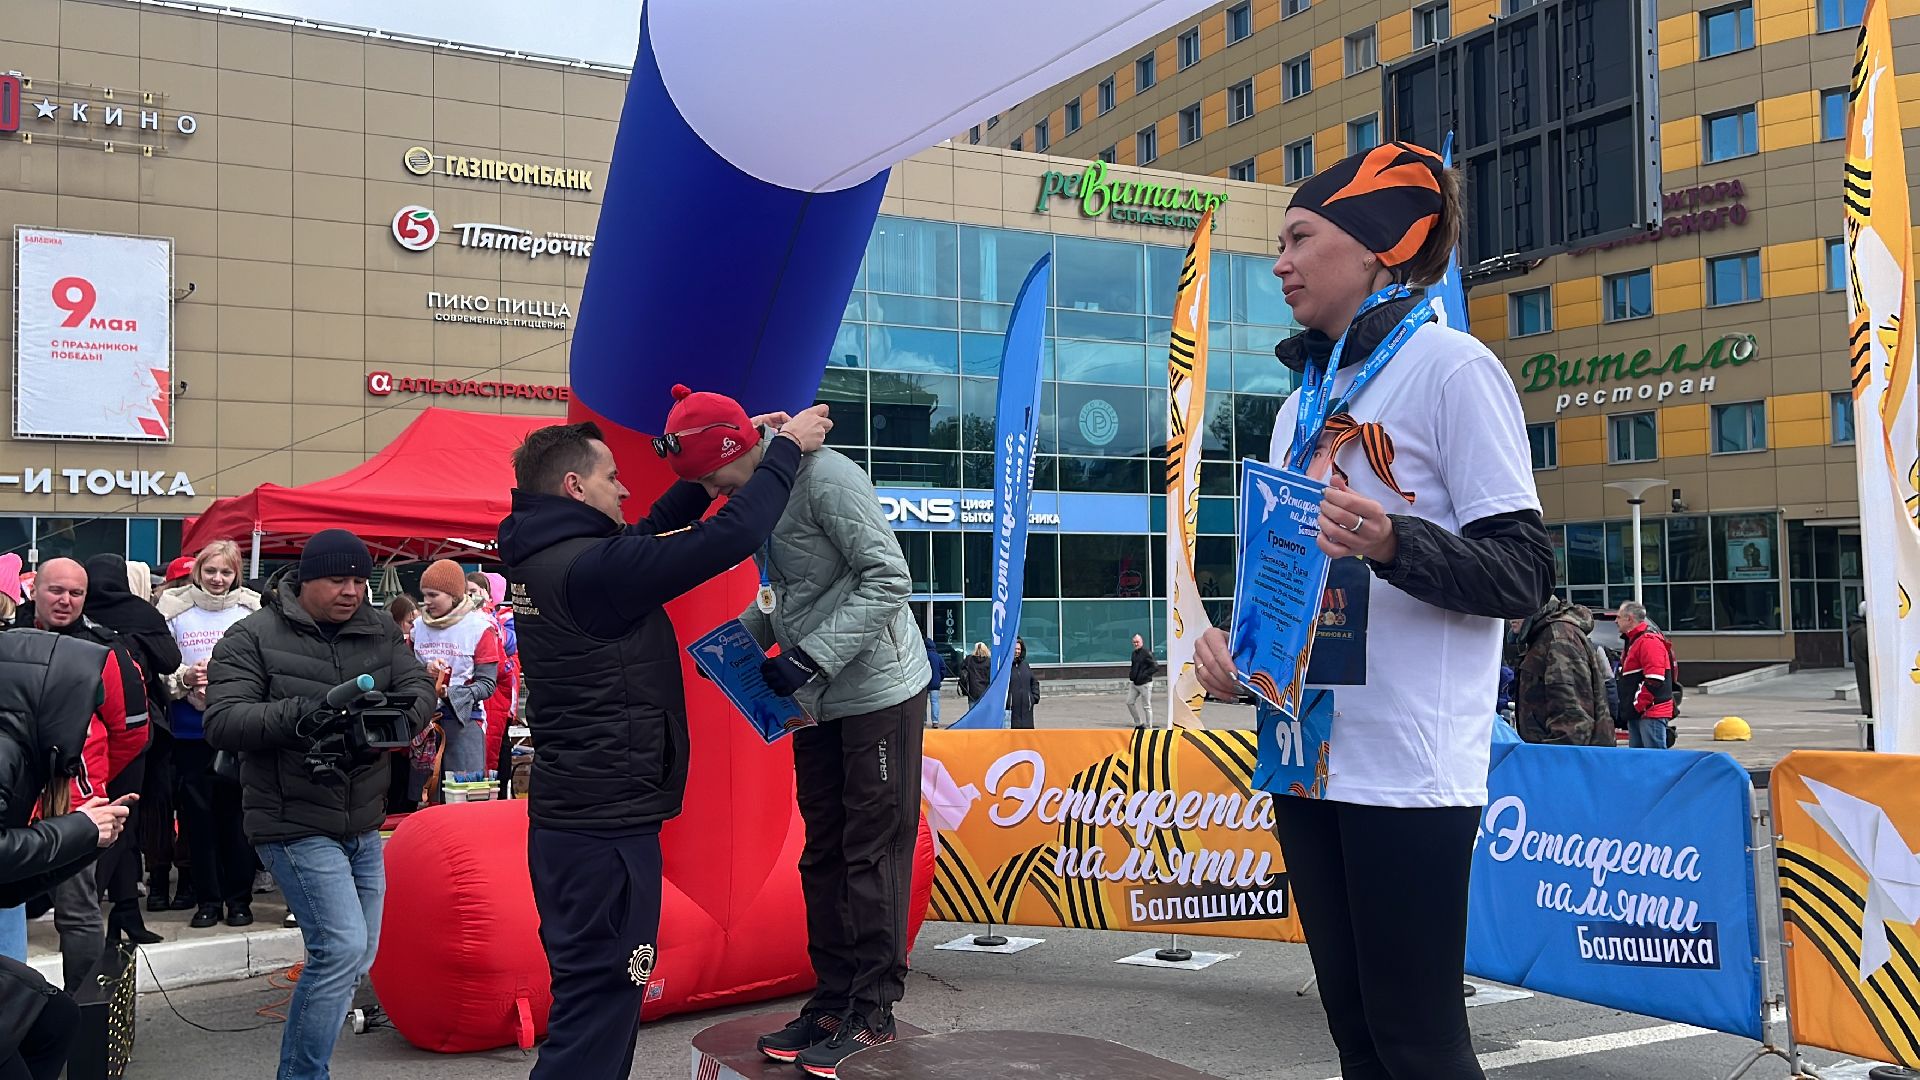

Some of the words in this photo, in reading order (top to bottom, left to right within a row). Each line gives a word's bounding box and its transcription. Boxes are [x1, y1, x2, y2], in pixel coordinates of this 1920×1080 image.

[72, 102, 197, 135] КИНО
[445, 155, 593, 191] ГАЗПРОМБАНК
[25, 235, 63, 246] БАЛАШИХА
[452, 223, 595, 258] Пятёрочк
[51, 276, 97, 328] 9
[89, 318, 137, 332] мая
[428, 292, 489, 311] ПИКО
[497, 298, 571, 318] ПИЦЦА
[435, 313, 509, 327] СОВРЕМЕННАЯ
[513, 319, 566, 330] ПИЦЦЕРИЯ
[51, 340, 59, 348] С
[62, 340, 138, 352] ПРАЗДНИКОМ
[51, 351, 102, 361] ПОБЕДЫ!
[1521, 334, 1757, 393] Вителло
[399, 377, 570, 401] АЛЬФАСТРАХОВ
[1556, 376, 1716, 413] ресторан
[62, 468, 196, 496] ТОЧКА
[960, 499, 994, 511] ЦИФР
[1267, 530, 1306, 556] Грамота
[182, 631, 225, 639] ВОЛОНТ
[1276, 721, 1304, 767] 91
[878, 745, 888, 781] CRAFT
[984, 750, 1276, 847] Эстафета
[1485, 795, 1702, 887] Эстафета
[1054, 845, 1276, 887] памяти
[1129, 888, 1284, 922] Балашиха
[1536, 880, 1702, 932] памяти
[1577, 926, 1715, 965] Балашиха
